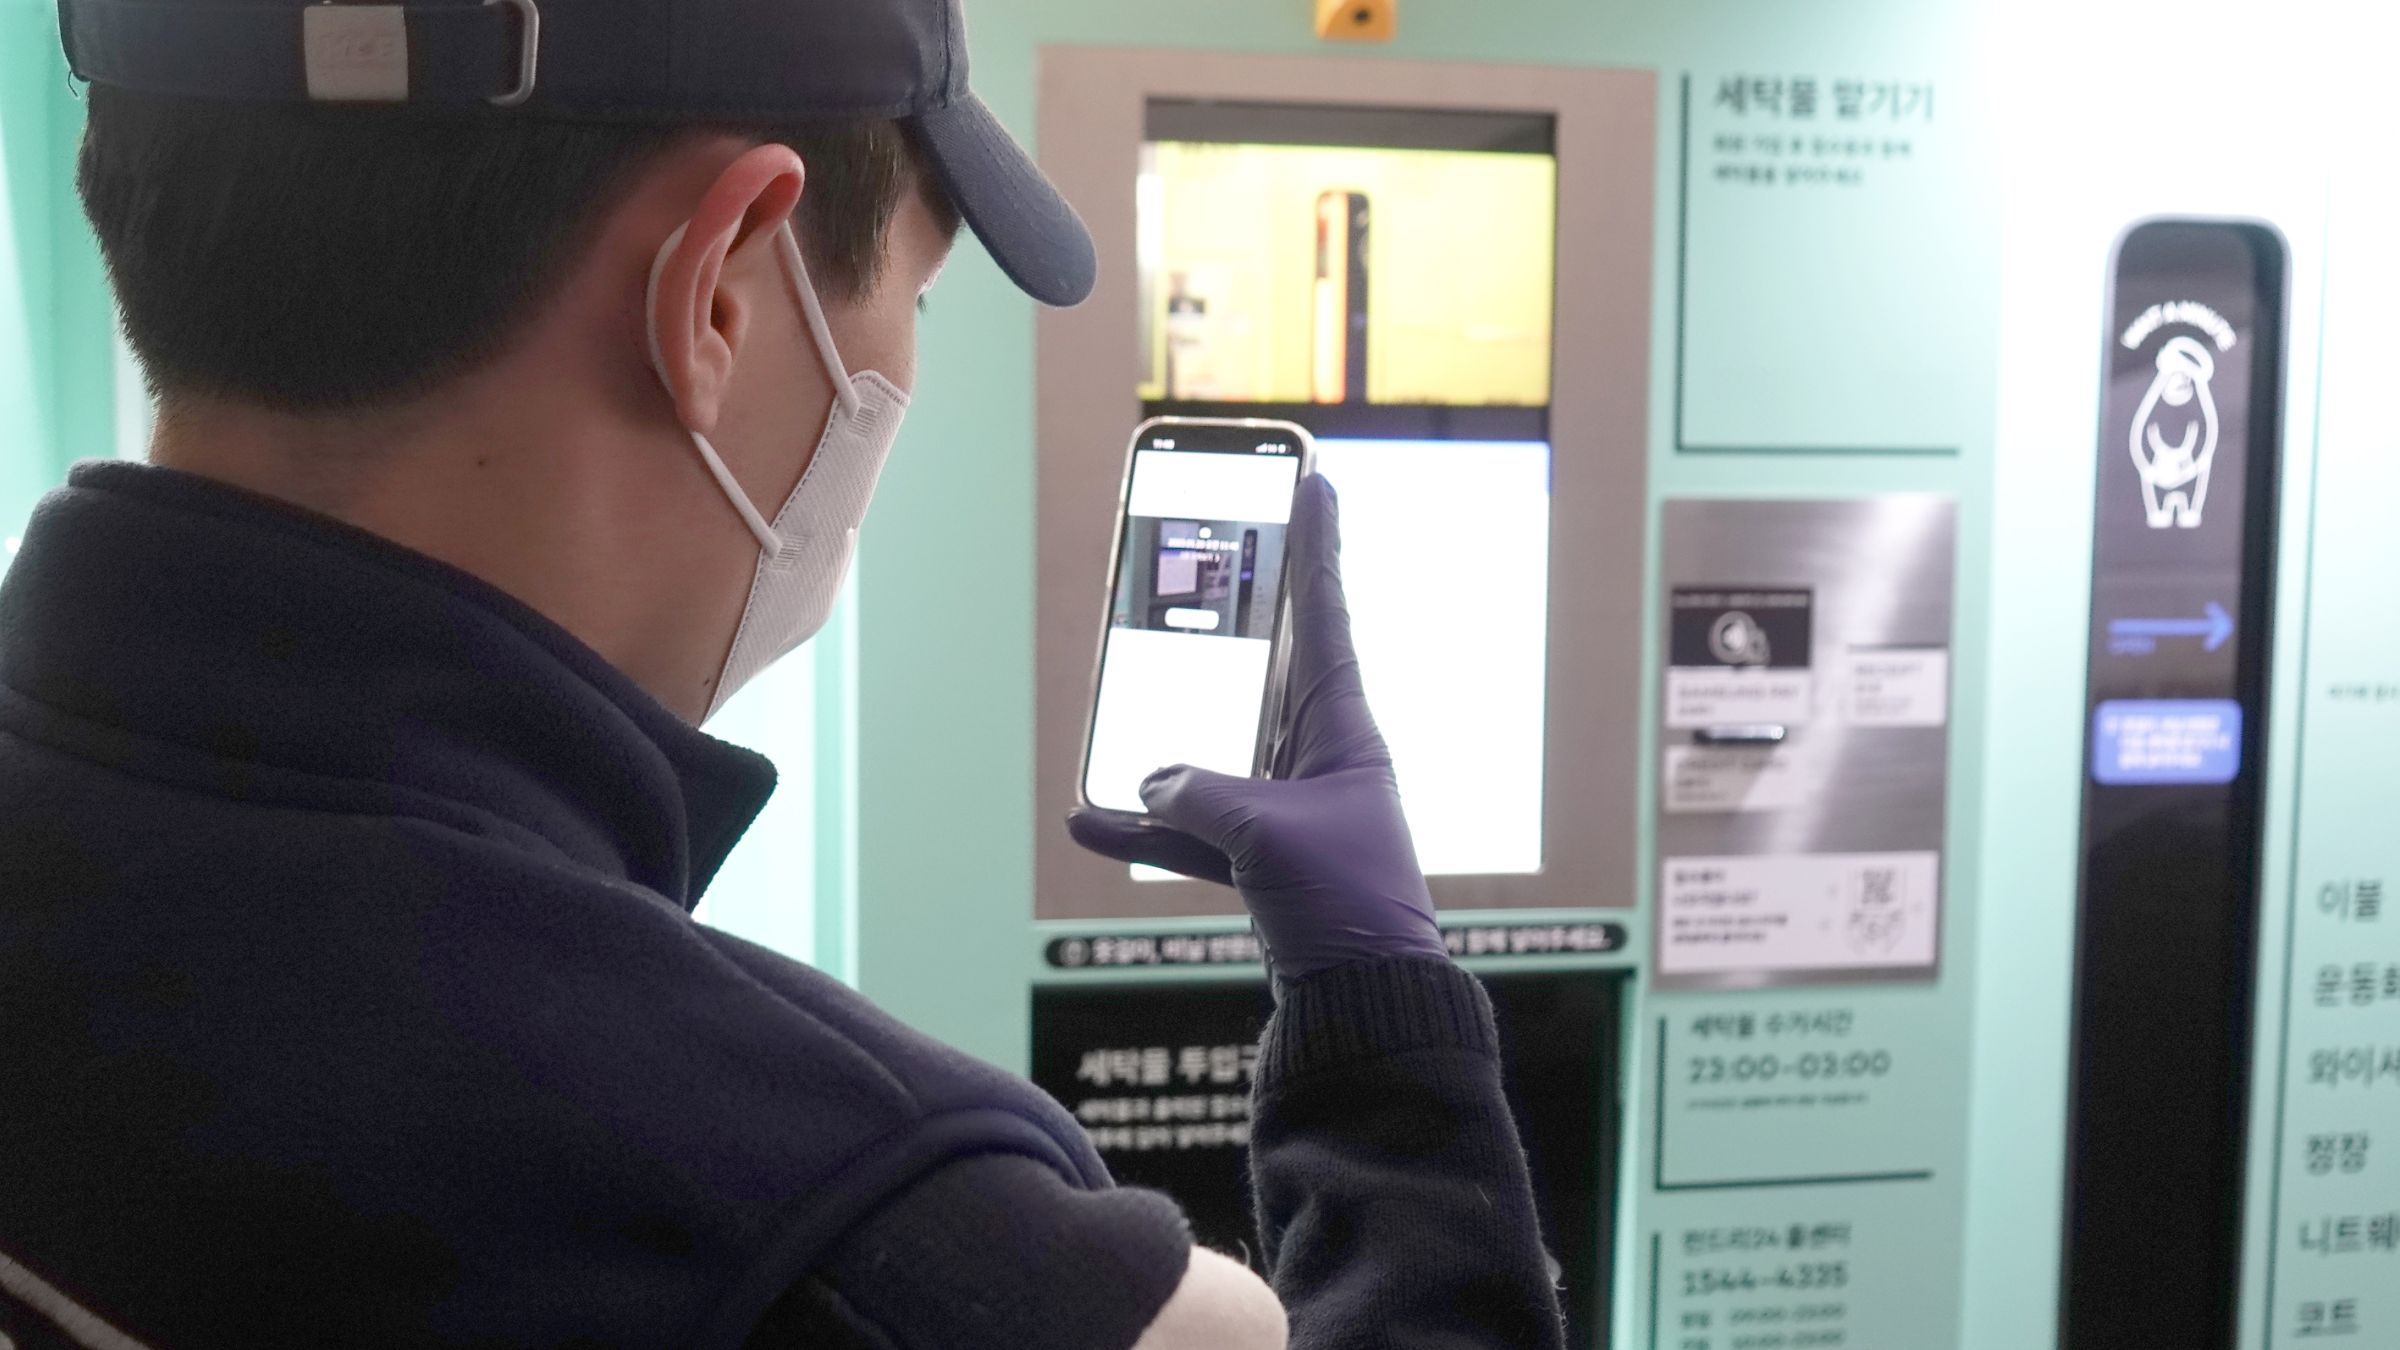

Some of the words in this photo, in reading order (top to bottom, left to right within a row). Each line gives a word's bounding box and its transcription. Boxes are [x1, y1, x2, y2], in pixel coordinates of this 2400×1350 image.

[1715, 75, 1816, 117] 세탁물
[1833, 77, 1933, 120] 맡기기
[2317, 879, 2381, 922] 이불
[1691, 1012, 1756, 1039] 세탁물
[1767, 1009, 1852, 1036] 수거시간
[1076, 1047, 1170, 1087] 세탁물
[1689, 1049, 1891, 1083] 23:00-03:00
[2306, 1131, 2369, 1176] 정장
[2293, 1300, 2359, 1338] 코트
